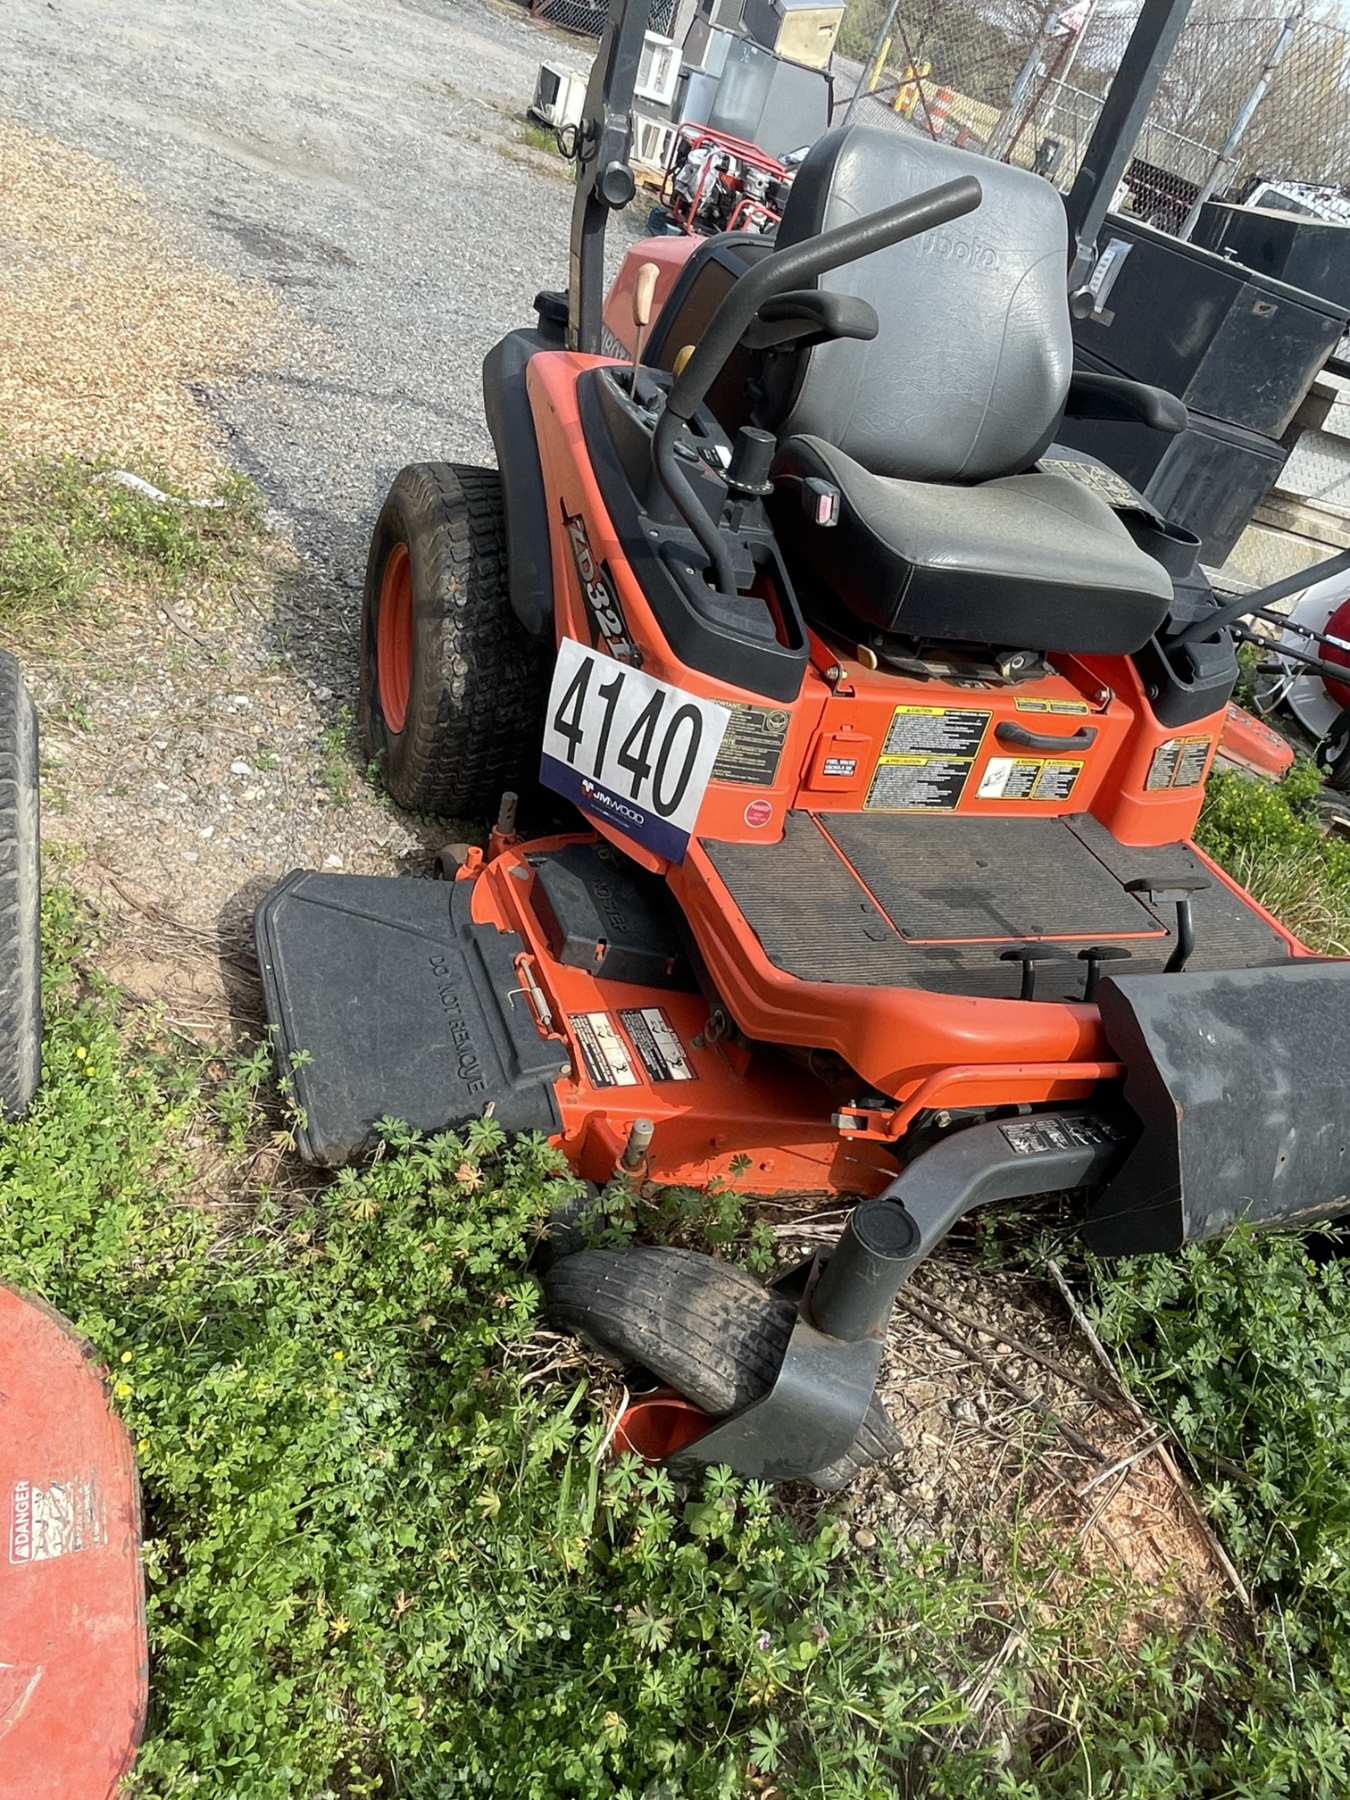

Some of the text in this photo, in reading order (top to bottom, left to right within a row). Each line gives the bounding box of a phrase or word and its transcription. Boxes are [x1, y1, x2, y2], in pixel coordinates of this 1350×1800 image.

[553, 656, 703, 818] 4140
[429, 954, 486, 1095] DO NOT REMOVE
[15, 1480, 30, 1546] DANGER
